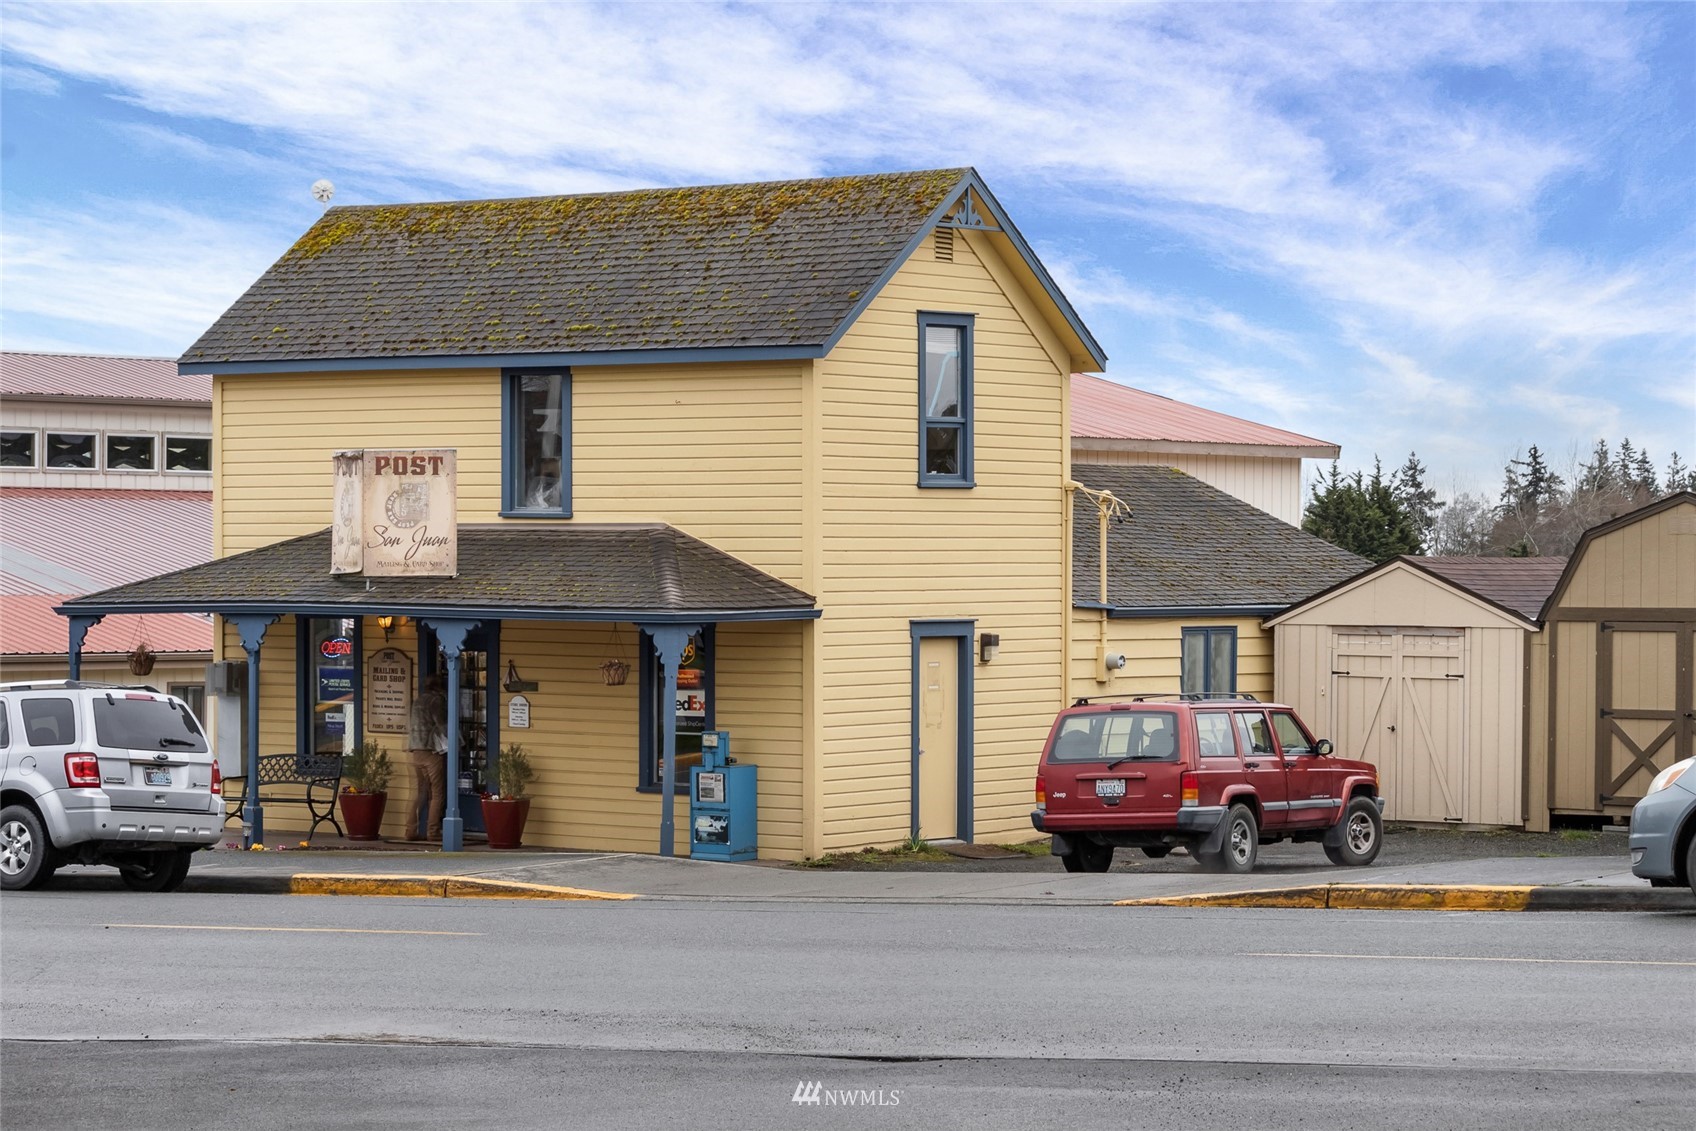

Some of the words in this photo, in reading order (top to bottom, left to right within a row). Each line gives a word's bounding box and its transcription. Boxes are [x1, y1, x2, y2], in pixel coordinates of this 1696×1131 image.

[375, 456, 443, 475] POST
[367, 525, 404, 548] San
[404, 525, 450, 560] Juan
[321, 641, 351, 654] OPEN
[372, 667, 399, 675] MAILING
[402, 667, 406, 675] &
[390, 675, 406, 683] SHOP
[676, 695, 705, 711] edEx
[1052, 791, 1067, 799] Jeep
